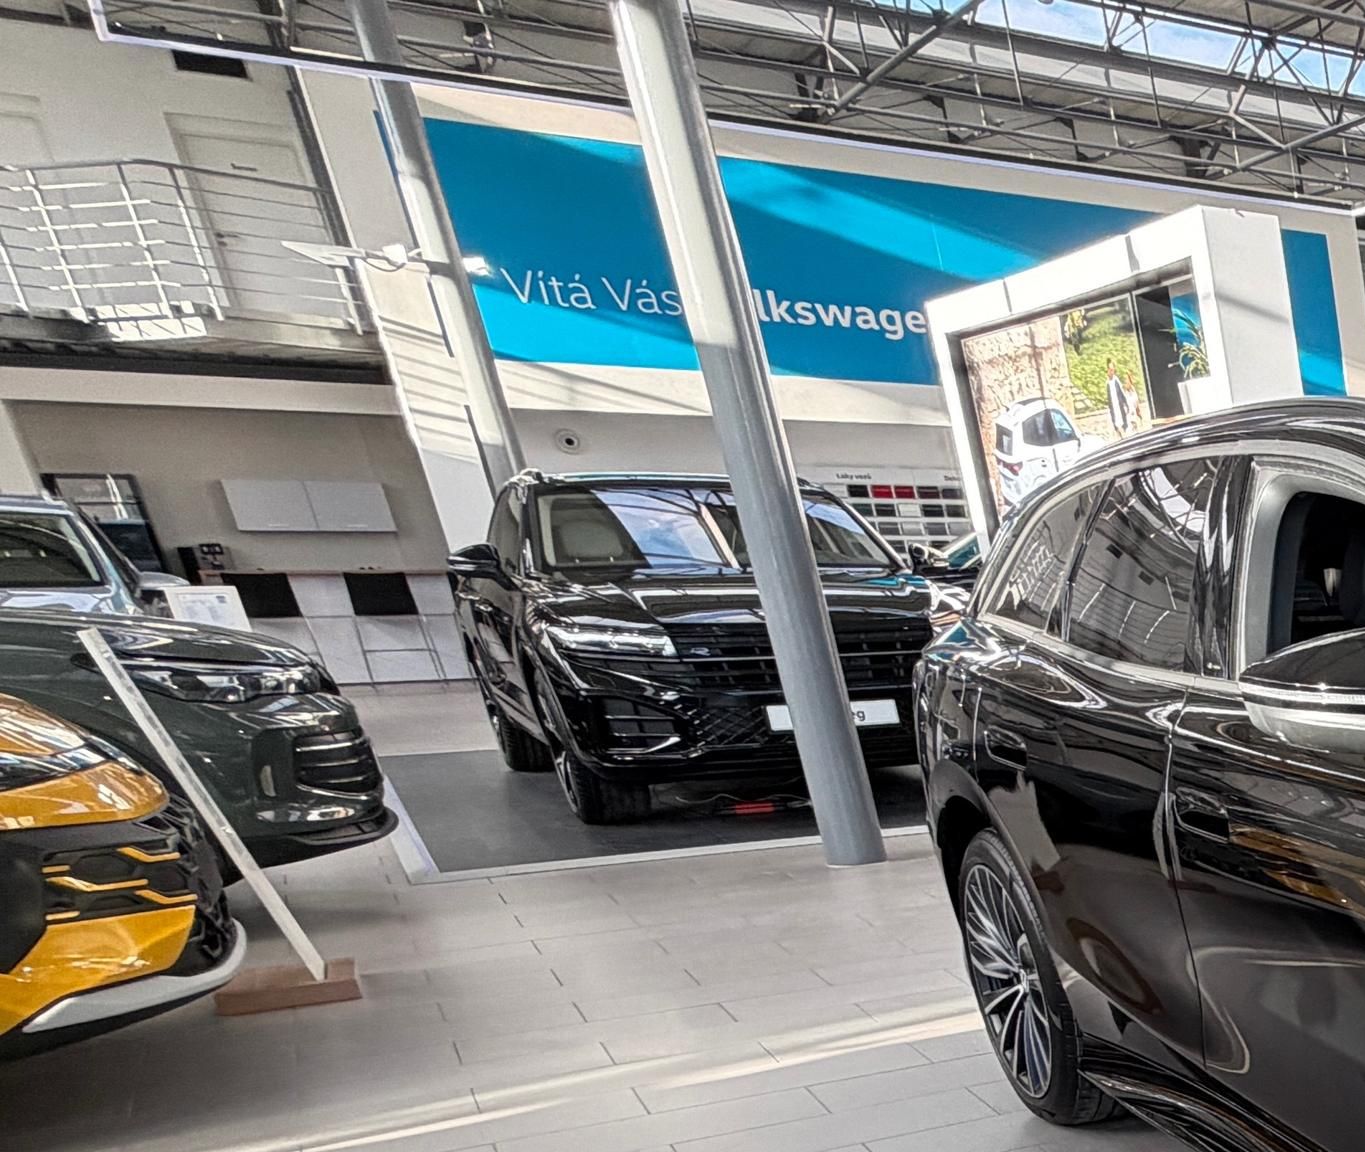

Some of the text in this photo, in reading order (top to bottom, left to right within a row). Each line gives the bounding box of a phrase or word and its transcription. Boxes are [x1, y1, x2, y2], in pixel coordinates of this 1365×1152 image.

[500, 267, 928, 341] Vítá Vás lkswage
